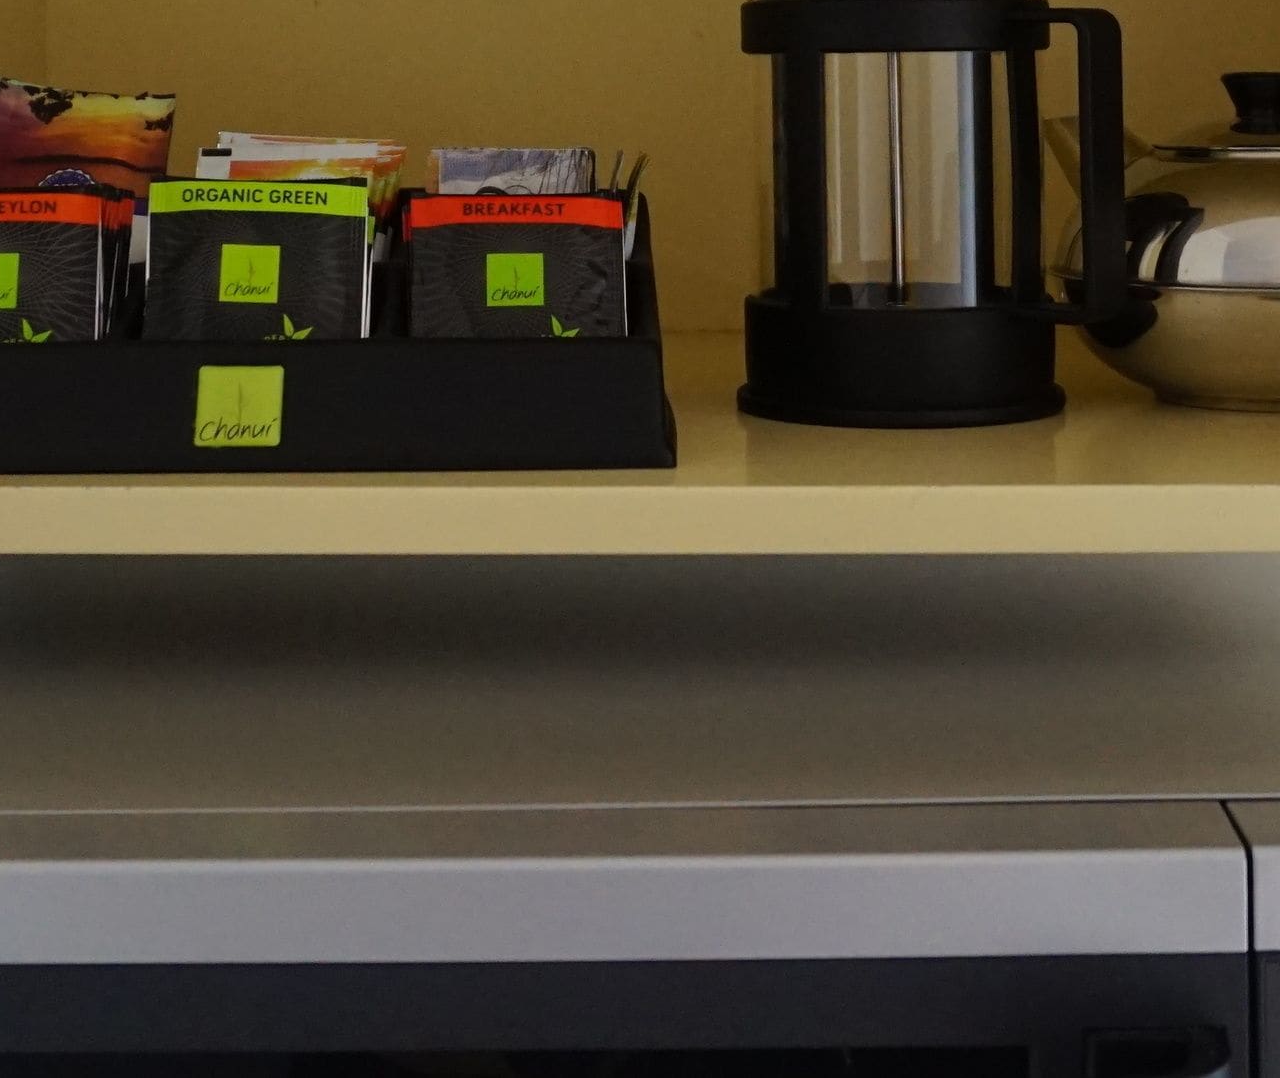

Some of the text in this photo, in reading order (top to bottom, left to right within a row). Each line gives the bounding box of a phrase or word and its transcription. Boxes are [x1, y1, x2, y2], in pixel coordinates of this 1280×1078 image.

[181, 187, 329, 206] ORGANIC GREEN
[462, 202, 567, 217] BREAKFAST
